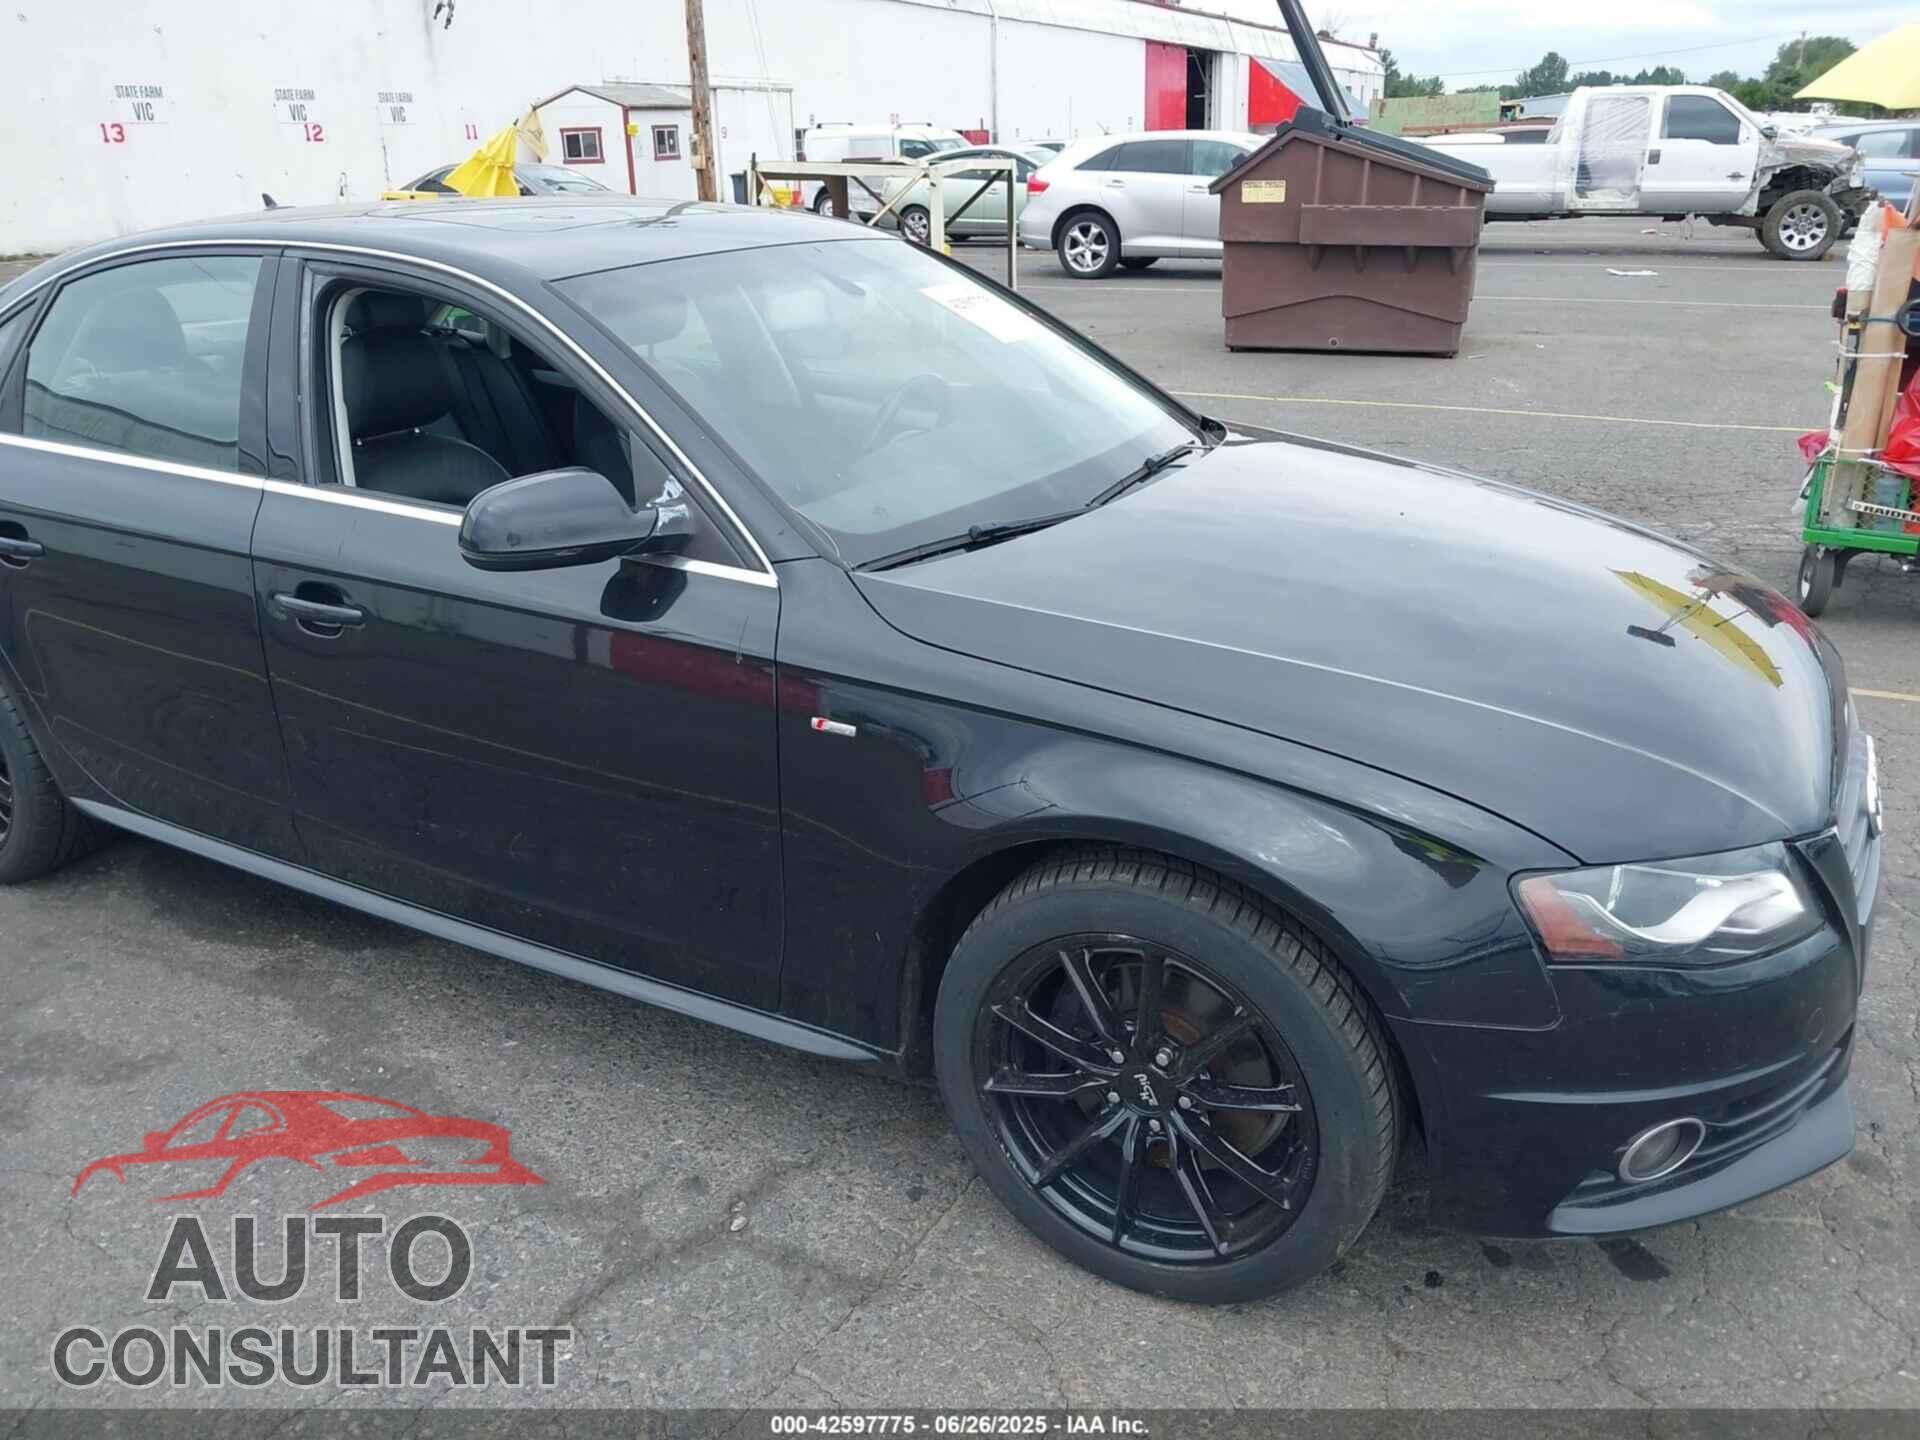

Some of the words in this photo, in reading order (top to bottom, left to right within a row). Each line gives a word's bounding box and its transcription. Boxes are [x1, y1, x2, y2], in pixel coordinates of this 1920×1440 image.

[114, 85, 138, 98] STATE
[139, 86, 163, 98] FARM
[131, 102, 154, 121] VIC
[288, 103, 307, 121] VIC
[390, 106, 406, 122] VIC
[100, 123, 125, 143] 13
[304, 123, 324, 142] 12
[465, 123, 478, 140] 11
